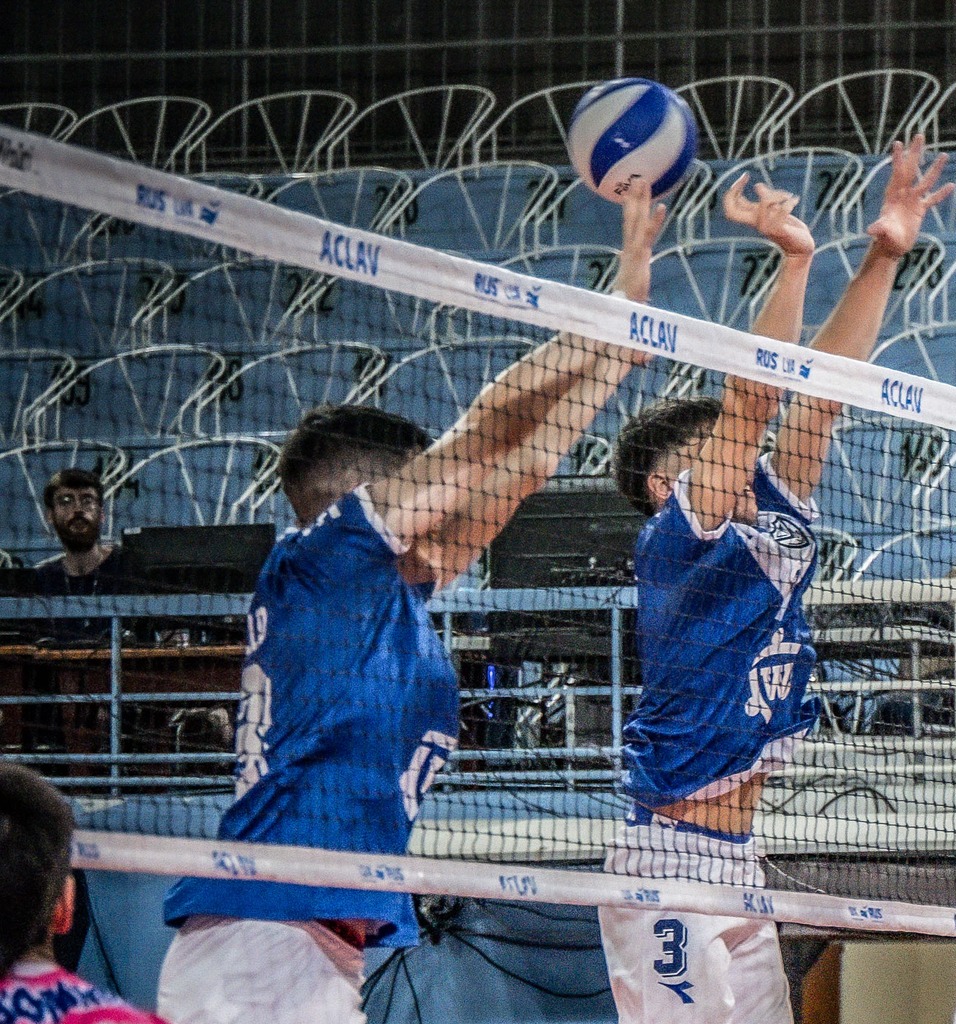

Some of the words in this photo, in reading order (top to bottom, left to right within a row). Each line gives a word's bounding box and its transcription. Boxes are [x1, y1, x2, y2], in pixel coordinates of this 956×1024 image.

[319, 230, 382, 277] ACLAV
[629, 311, 678, 354] ACLAV
[756, 347, 779, 371] RUS
[880, 377, 924, 414] ACLAV
[653, 918, 688, 978] 3
